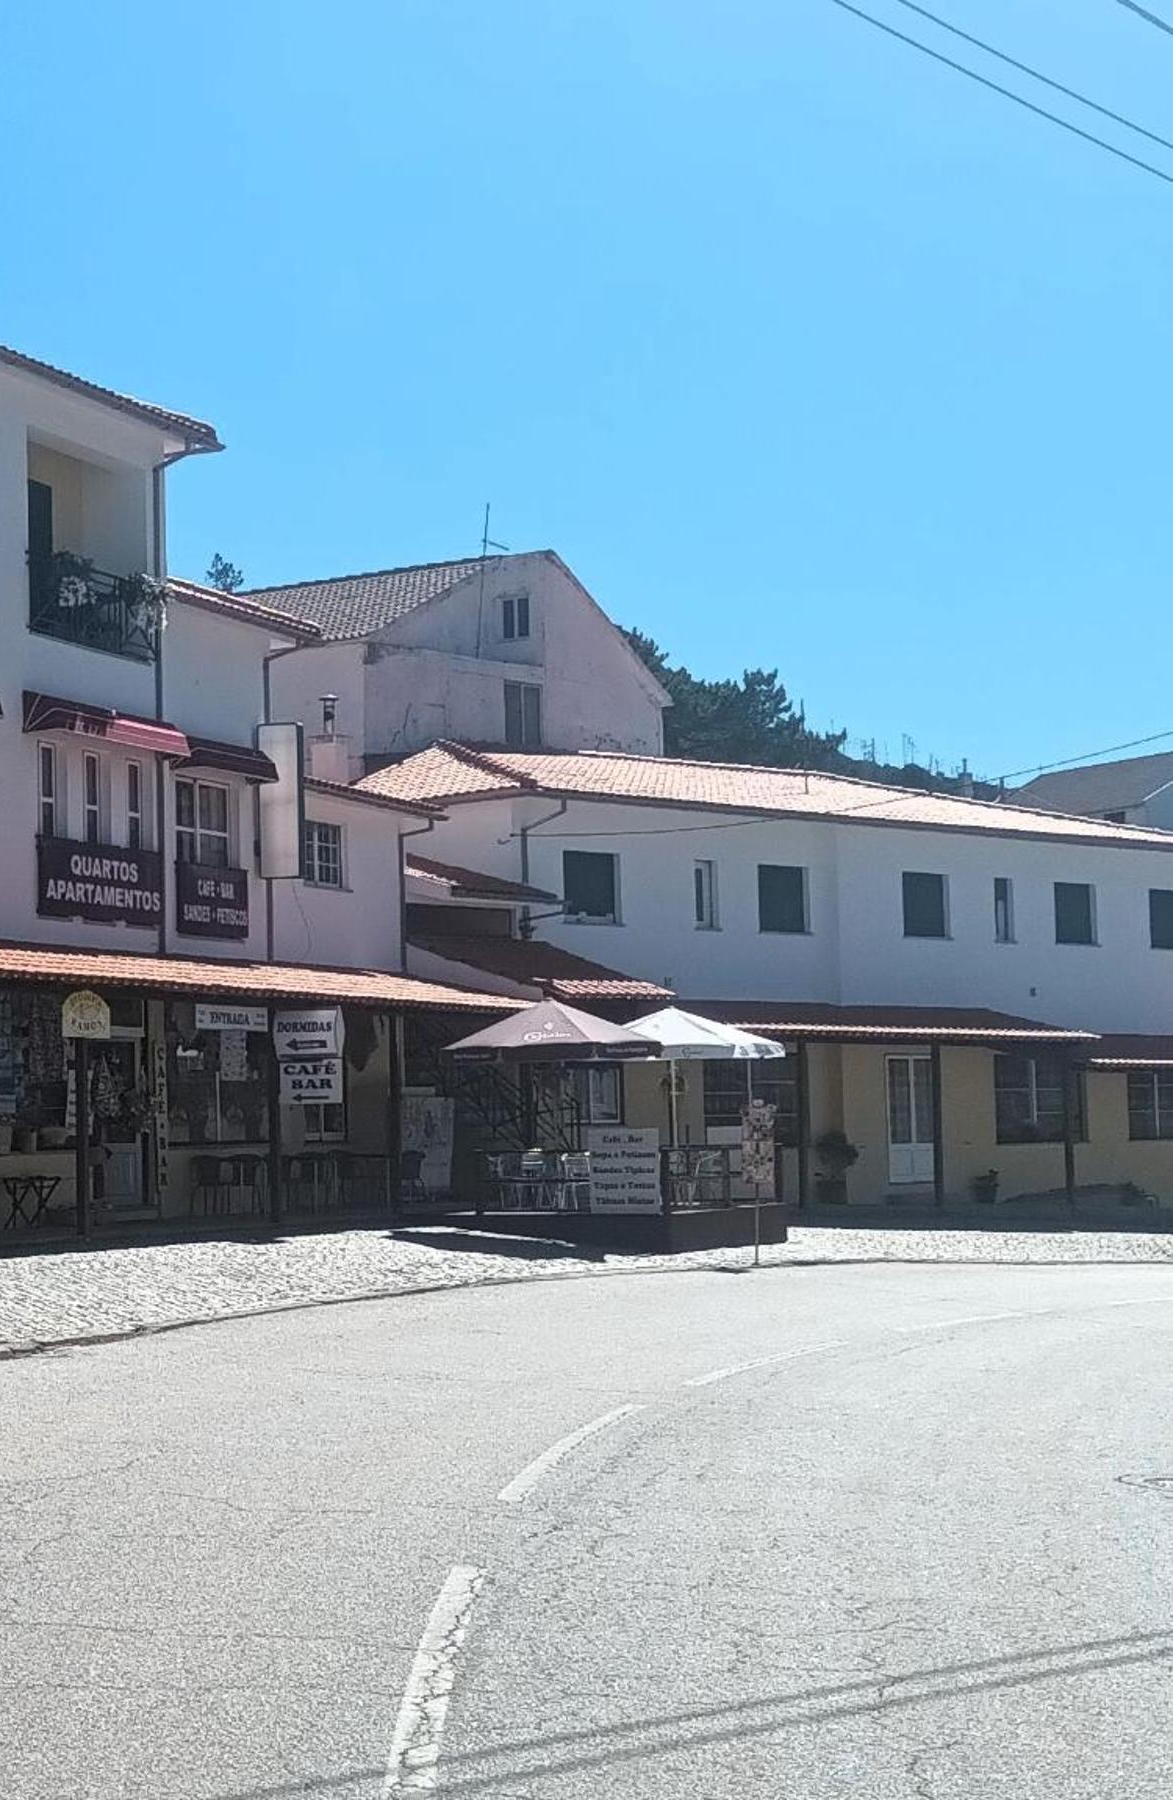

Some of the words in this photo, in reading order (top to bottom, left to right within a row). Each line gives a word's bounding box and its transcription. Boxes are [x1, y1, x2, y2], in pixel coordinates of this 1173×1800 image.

[70, 854, 139, 883] QUARTOS
[46, 878, 161, 912] APARTAMENTOS
[183, 903, 211, 923] SANDES
[216, 907, 248, 927] PETISCOS
[209, 1011, 250, 1025] ENTRADA
[277, 1020, 332, 1033] DORMIDAS
[283, 1060, 337, 1076] CAFÉ
[291, 1078, 333, 1090] BAR
